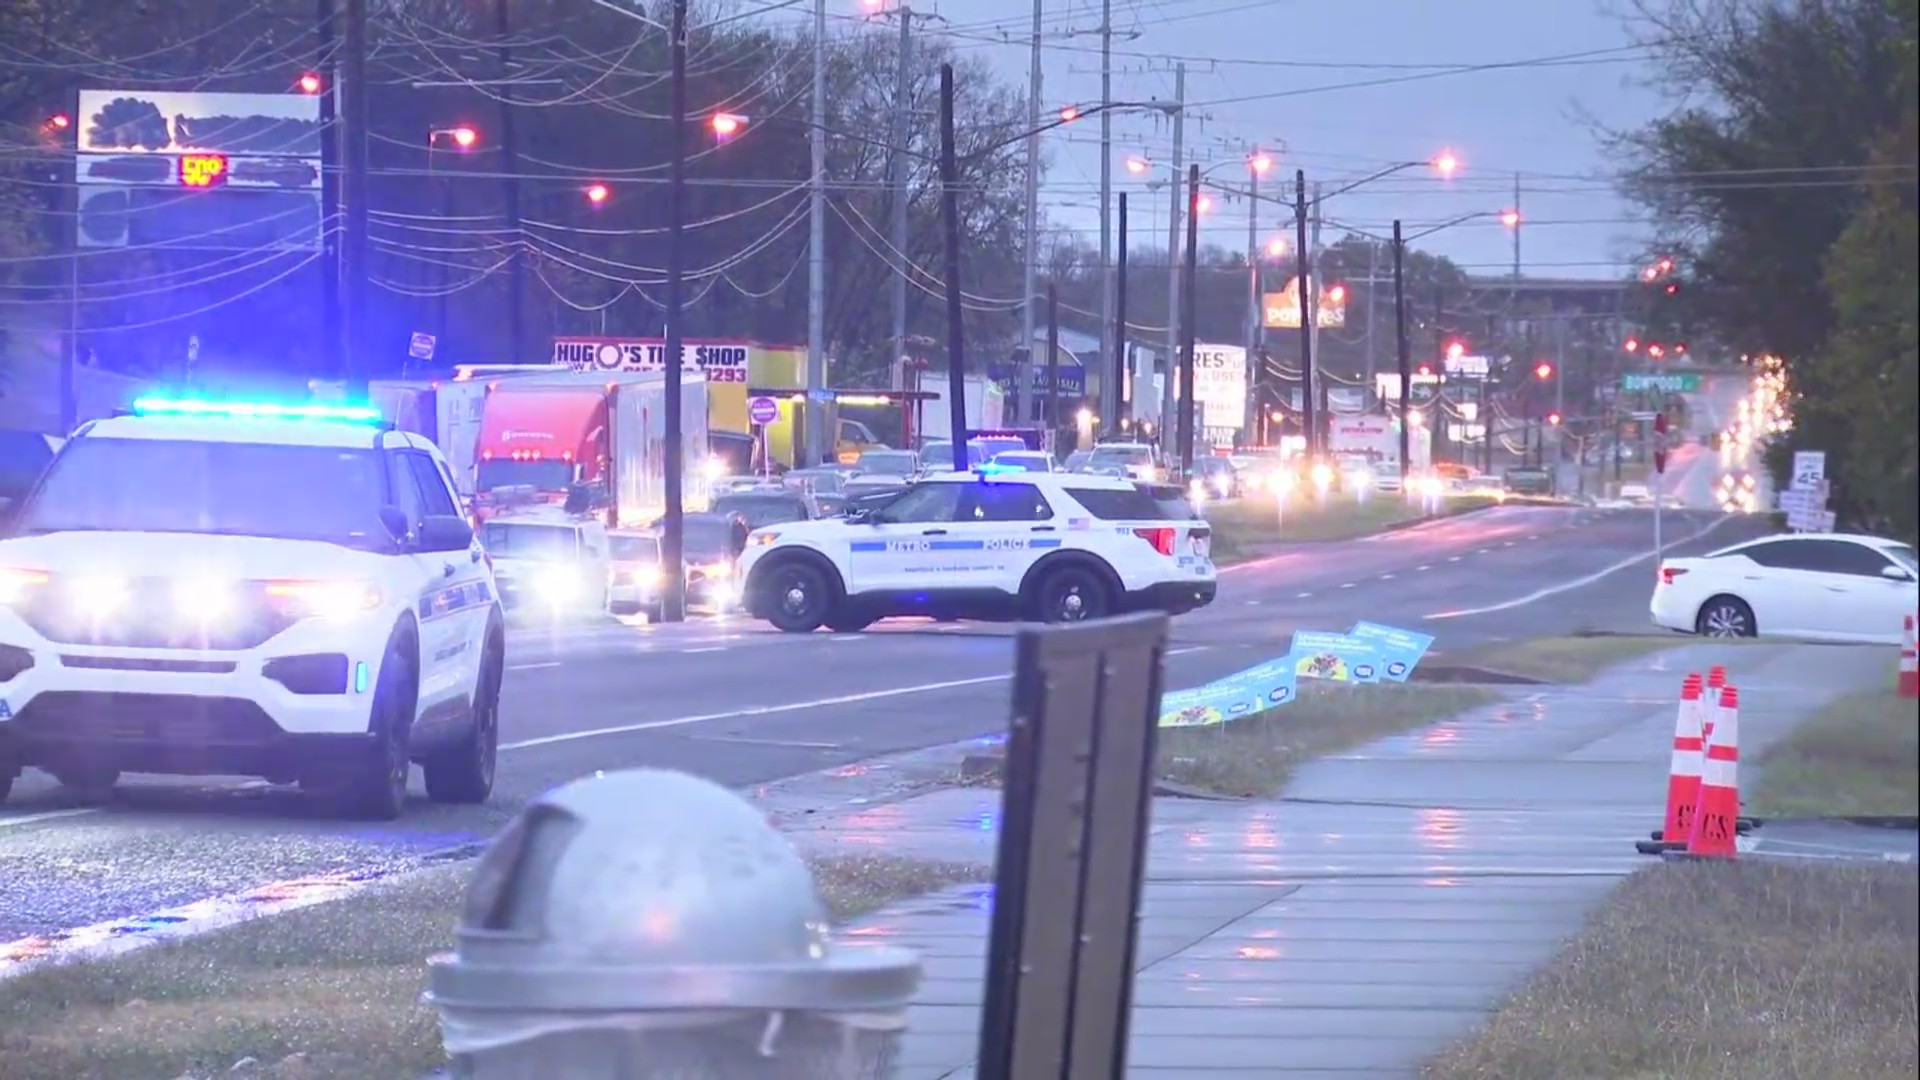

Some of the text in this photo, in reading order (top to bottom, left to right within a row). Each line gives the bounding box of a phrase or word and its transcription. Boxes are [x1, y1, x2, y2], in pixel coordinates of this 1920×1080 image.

[695, 346, 747, 367] SHOP
[886, 537, 1032, 552] METRO POLICE
